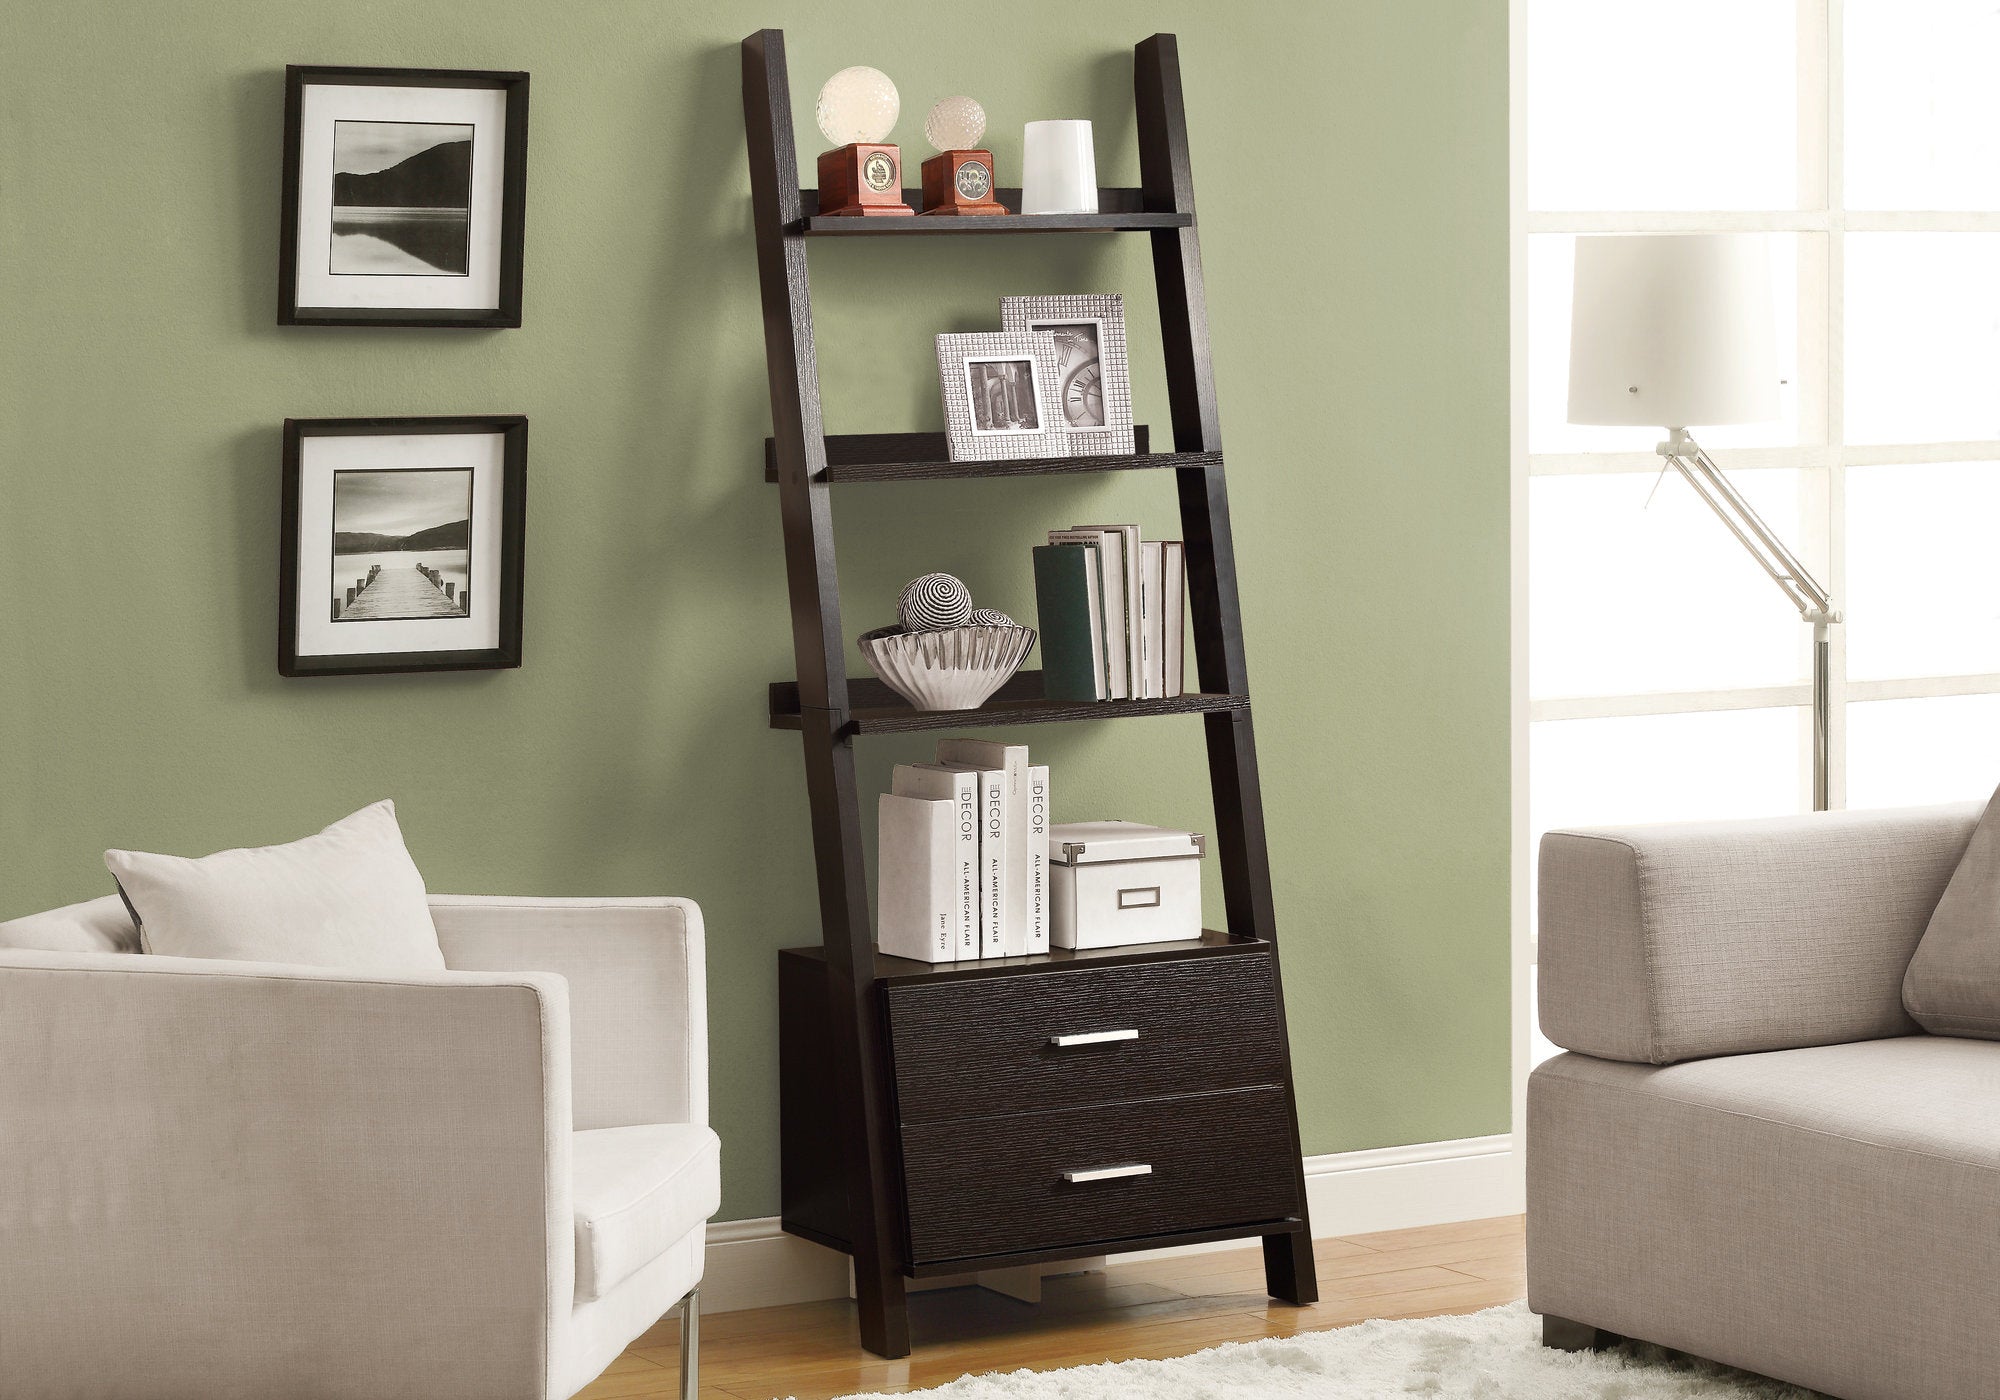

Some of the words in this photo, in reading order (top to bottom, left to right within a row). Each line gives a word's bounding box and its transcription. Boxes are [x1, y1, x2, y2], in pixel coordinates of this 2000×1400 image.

[961, 792, 972, 841] DECOR
[989, 790, 1000, 838] DECOR
[1032, 786, 1043, 834] DECOR
[939, 913, 947, 929] Jane
[939, 932, 947, 950] Eyre
